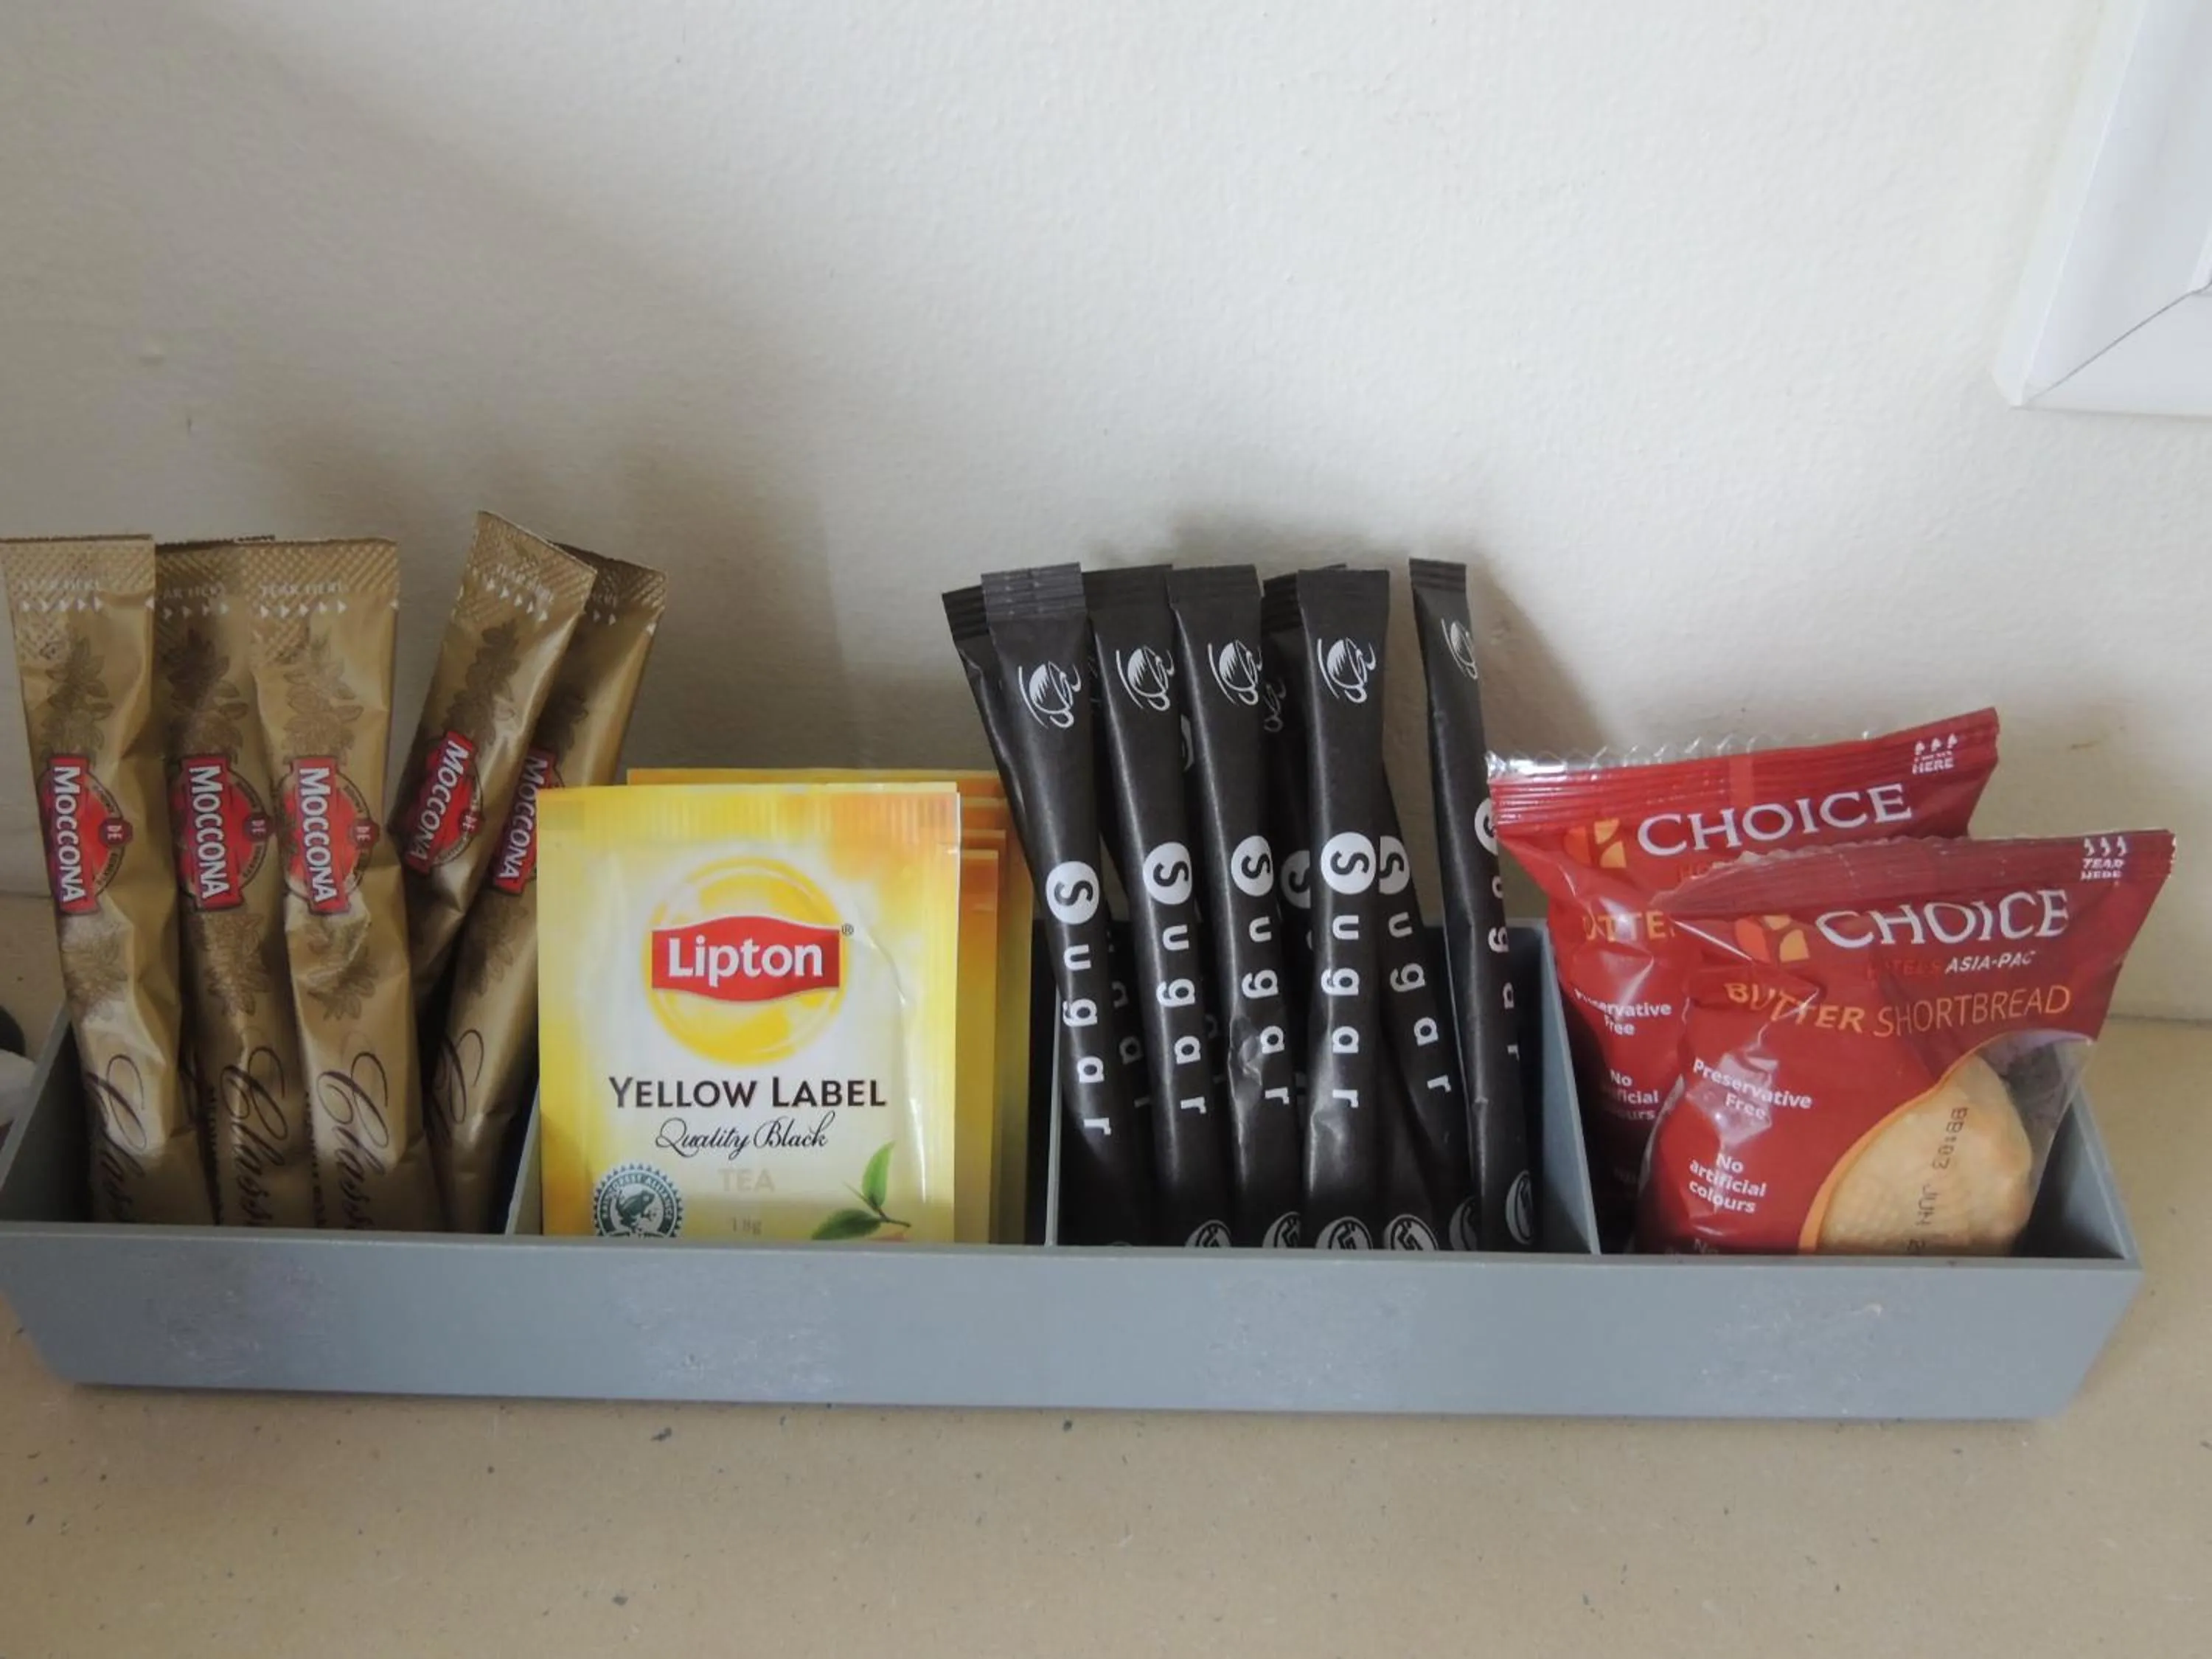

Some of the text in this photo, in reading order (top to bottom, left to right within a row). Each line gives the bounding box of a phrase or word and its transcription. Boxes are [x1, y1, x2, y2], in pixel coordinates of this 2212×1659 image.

[189, 765, 230, 899] MOCCONA
[408, 740, 470, 861] MOCCONA
[499, 755, 549, 880] MOCCONA
[1637, 783, 1913, 856] CHOICE
[54, 765, 86, 903] MOCCONA
[299, 767, 338, 903] MOCCONA
[1816, 889, 2070, 949] CHOICE
[667, 936, 824, 987] Lipton
[1144, 843, 1207, 1114] Sugar
[1232, 837, 1290, 1105] Sugar
[1321, 832, 1377, 1108] Sugar
[1380, 836, 1451, 1093] Sugar
[1047, 863, 1112, 1135] Sugar
[1724, 981, 2070, 1038] BUTTER SHORTBREAD
[608, 1077, 887, 1108] YELLOW LABEL
[1693, 1057, 1813, 1110] Preservative
[1725, 1093, 1768, 1121] Free
[655, 1110, 836, 1161] Quality Black
[1716, 1153, 1745, 1174] No
[717, 1168, 776, 1192] TEA
[1689, 1159, 1768, 1198] artificial
[1689, 1180, 1756, 1214] colours
